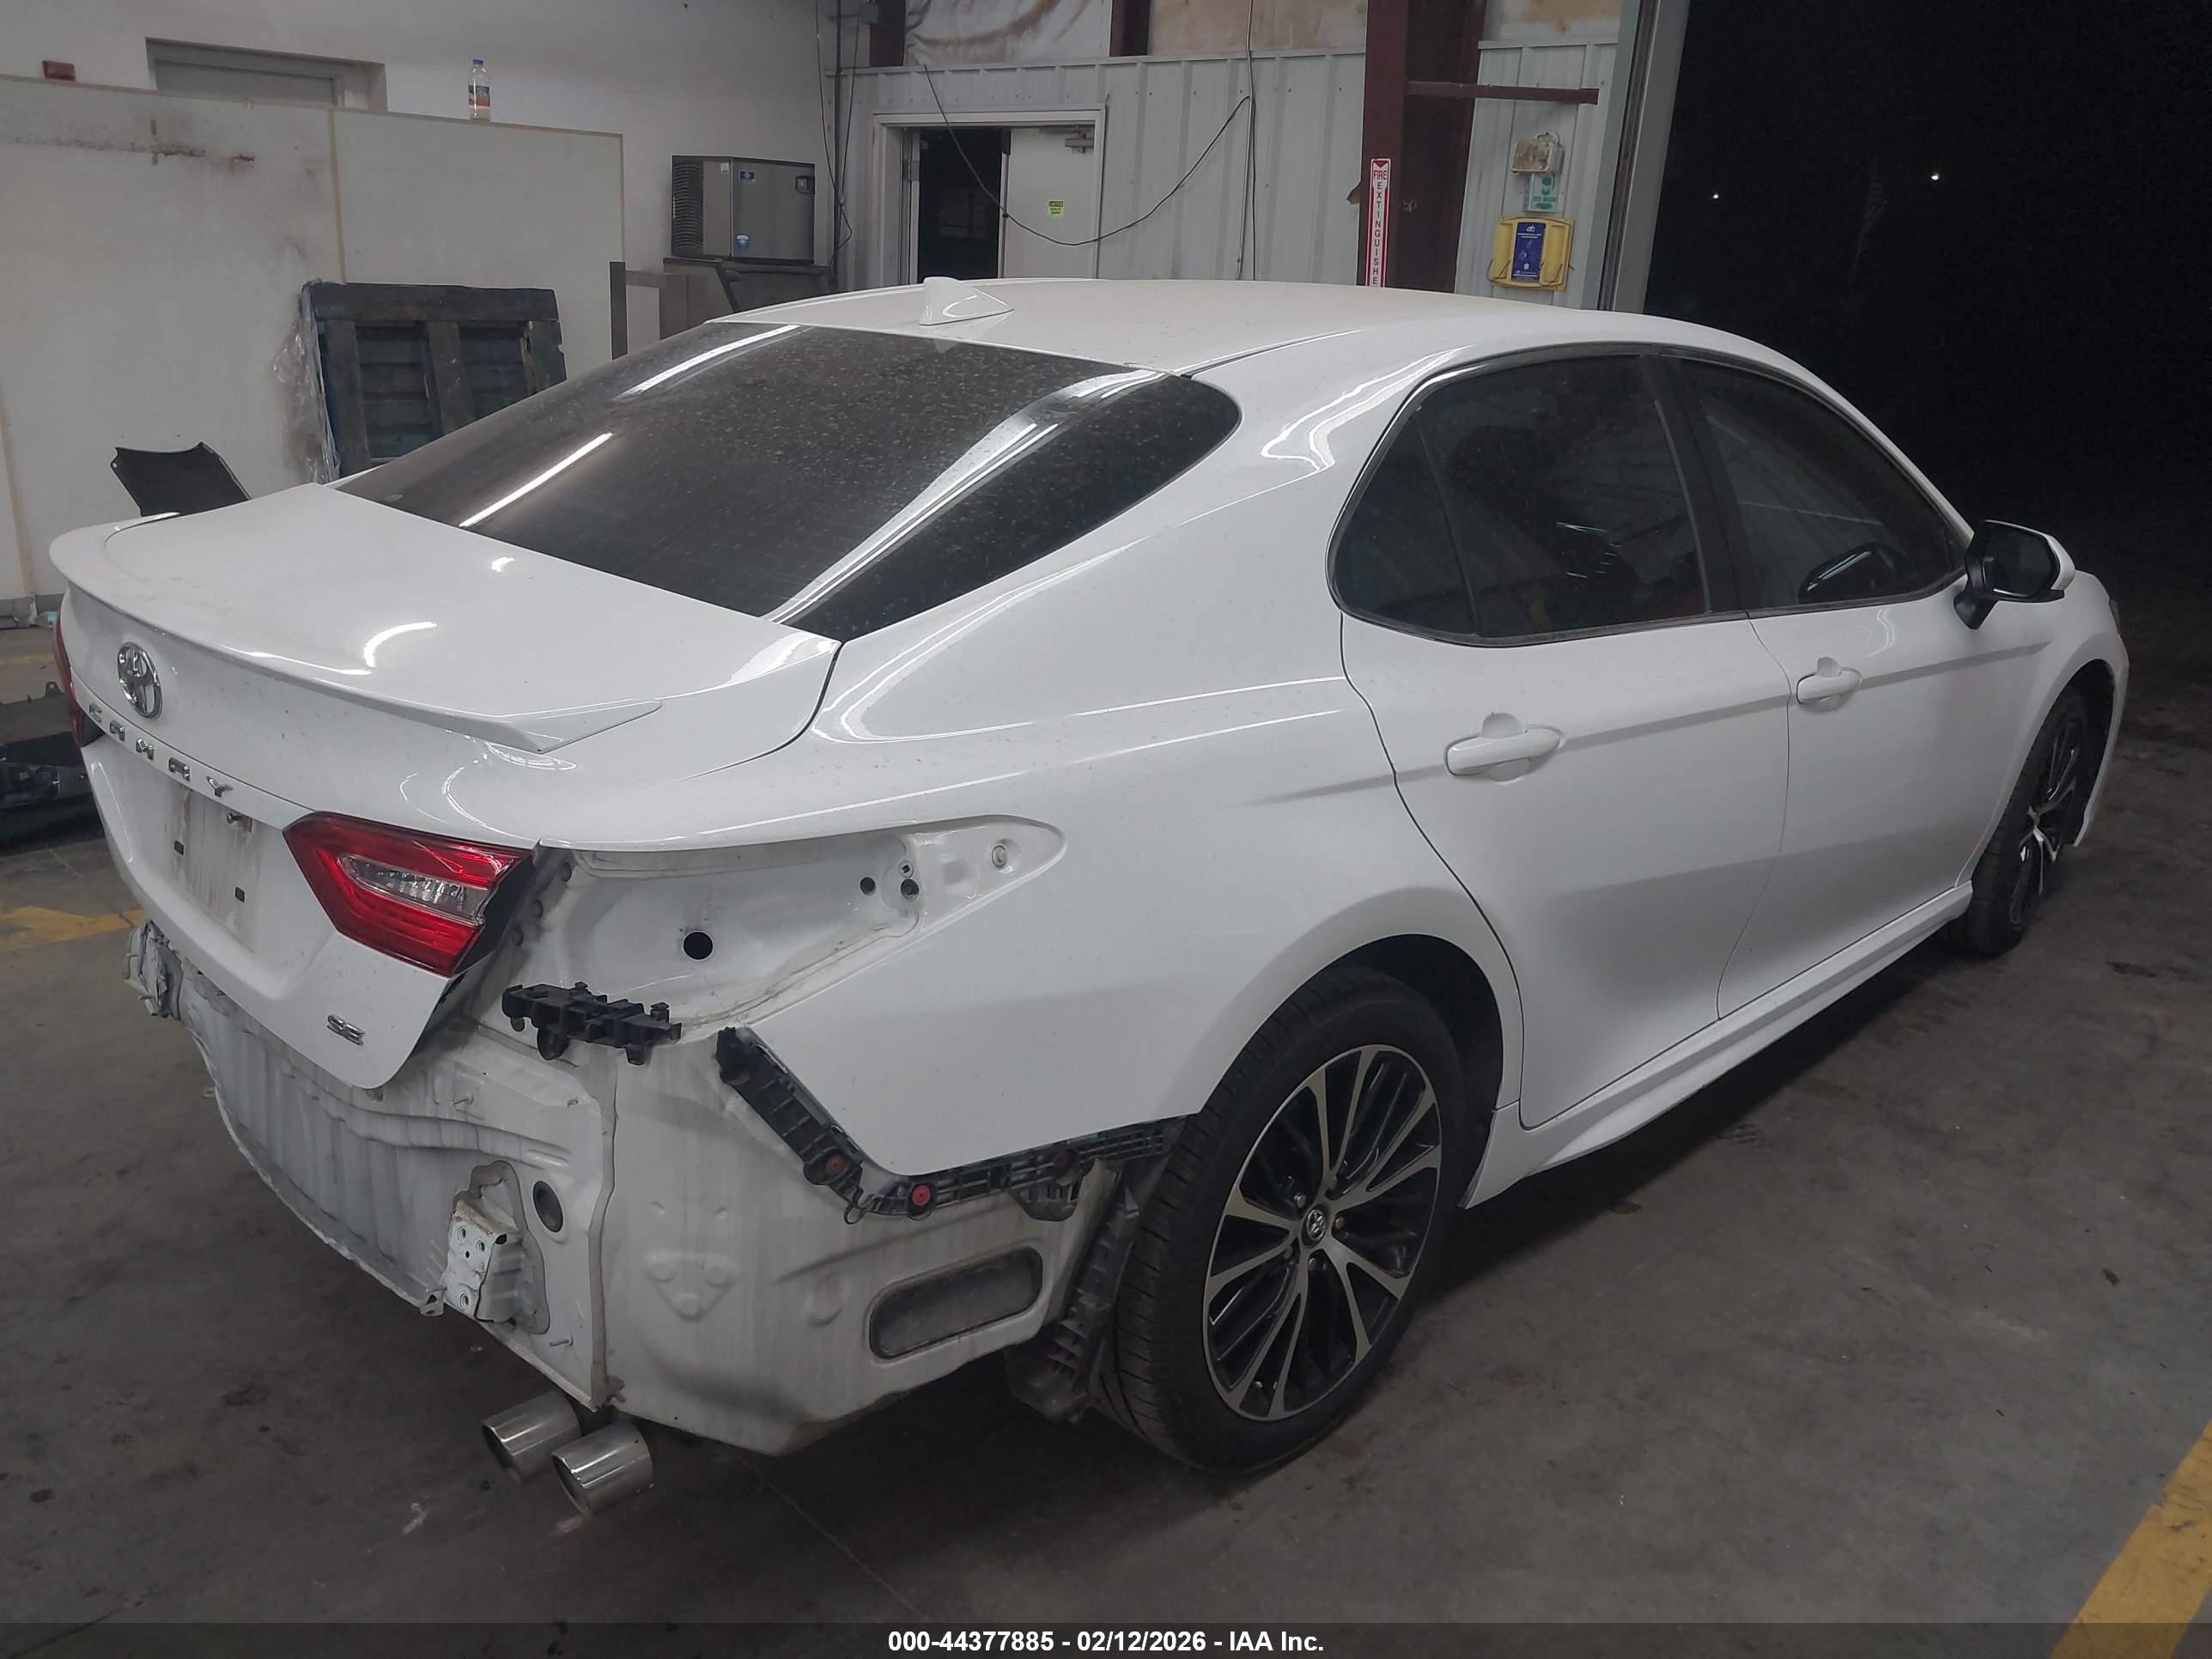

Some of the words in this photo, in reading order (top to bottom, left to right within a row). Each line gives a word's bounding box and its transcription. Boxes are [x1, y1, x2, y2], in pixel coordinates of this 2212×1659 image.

[1374, 170, 1388, 180] FIRE
[1372, 181, 1382, 287] EXTINGUISHE
[89, 702, 234, 798] CAMRY
[326, 1015, 365, 1046] SE
